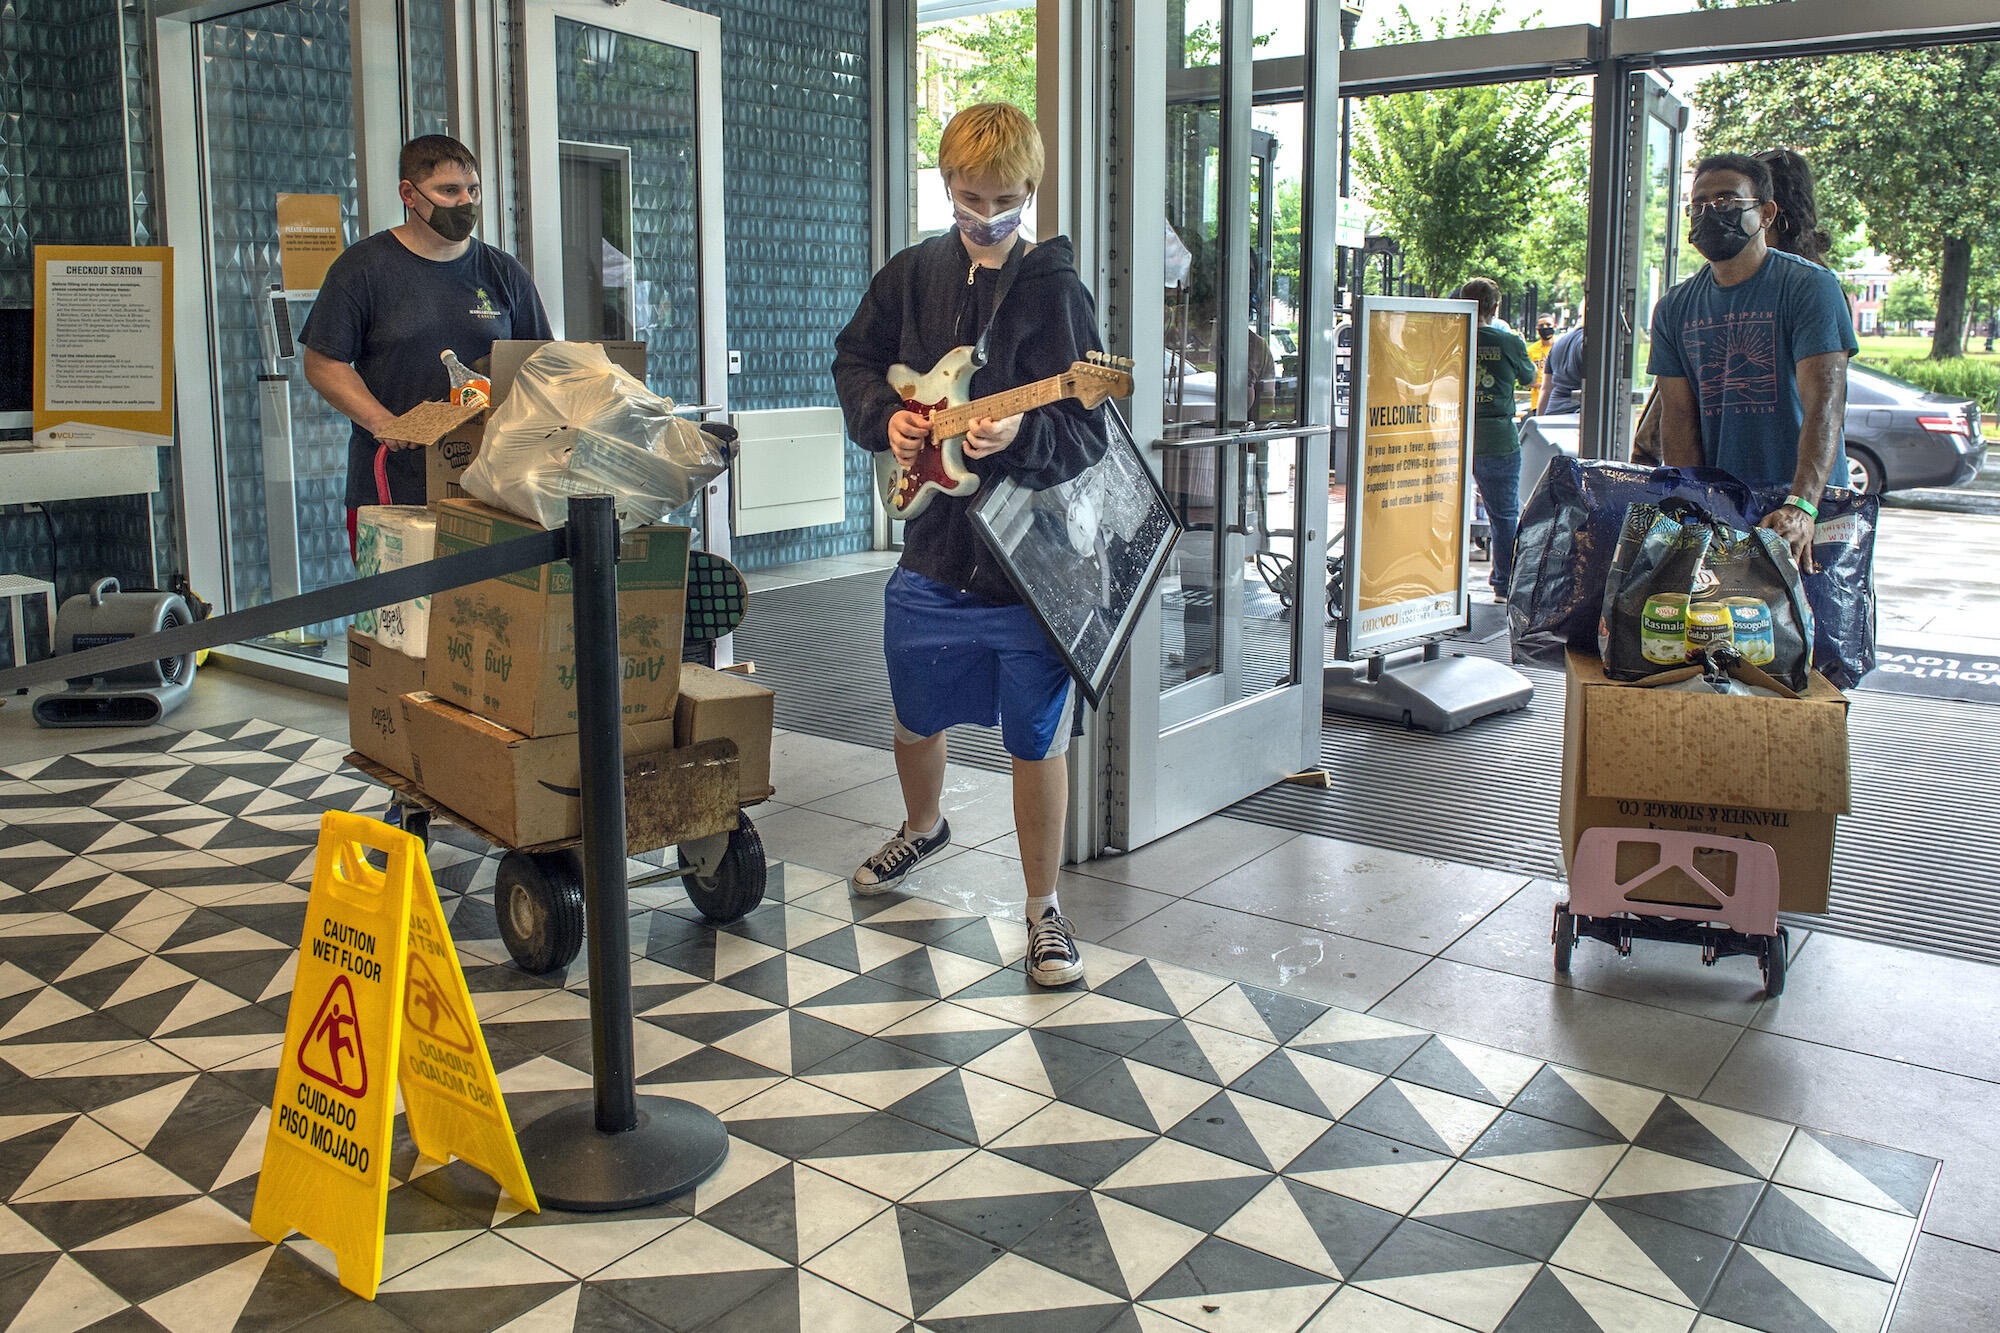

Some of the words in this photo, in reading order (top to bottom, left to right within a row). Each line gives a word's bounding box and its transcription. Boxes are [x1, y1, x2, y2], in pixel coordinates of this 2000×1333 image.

[66, 266, 108, 275] CHECKOUT
[110, 266, 143, 275] STATION
[1369, 405, 1423, 427] WELCOME
[1425, 403, 1437, 423] TO
[443, 441, 472, 460] OREO
[1375, 446, 1386, 458] you
[1388, 443, 1401, 454] have
[451, 456, 469, 469] mini
[1367, 463, 1394, 477] symptoms
[1396, 460, 1402, 471] of
[1403, 458, 1428, 471] COVID-19
[1429, 459, 1435, 468] or
[1367, 480, 1388, 494] exposed
[1389, 480, 1395, 489] to
[1397, 479, 1420, 488] someone
[1381, 498, 1388, 509] do
[1389, 496, 1398, 507] not
[1399, 495, 1413, 505] enter
[1414, 493, 1422, 504] the
[1644, 618, 1685, 631] Rasmala
[1733, 619, 1770, 632] ossogolla
[1687, 629, 1709, 640] Gulab
[447, 635, 473, 668] Soft
[485, 648, 512, 683] Ang
[622, 654, 665, 682] Ang
[1616, 800, 1639, 817] CO.
[1643, 802, 1704, 821] STORAGE
[1709, 807, 1718, 822] &
[1721, 807, 1790, 828] TRANSFER
[324, 918, 376, 955] CAUTION
[313, 937, 339, 964] WET
[341, 949, 382, 984] FLOOR
[297, 1082, 356, 1131] CUIDADO
[279, 1104, 308, 1139] PISO
[310, 1121, 369, 1173] MOJADO
